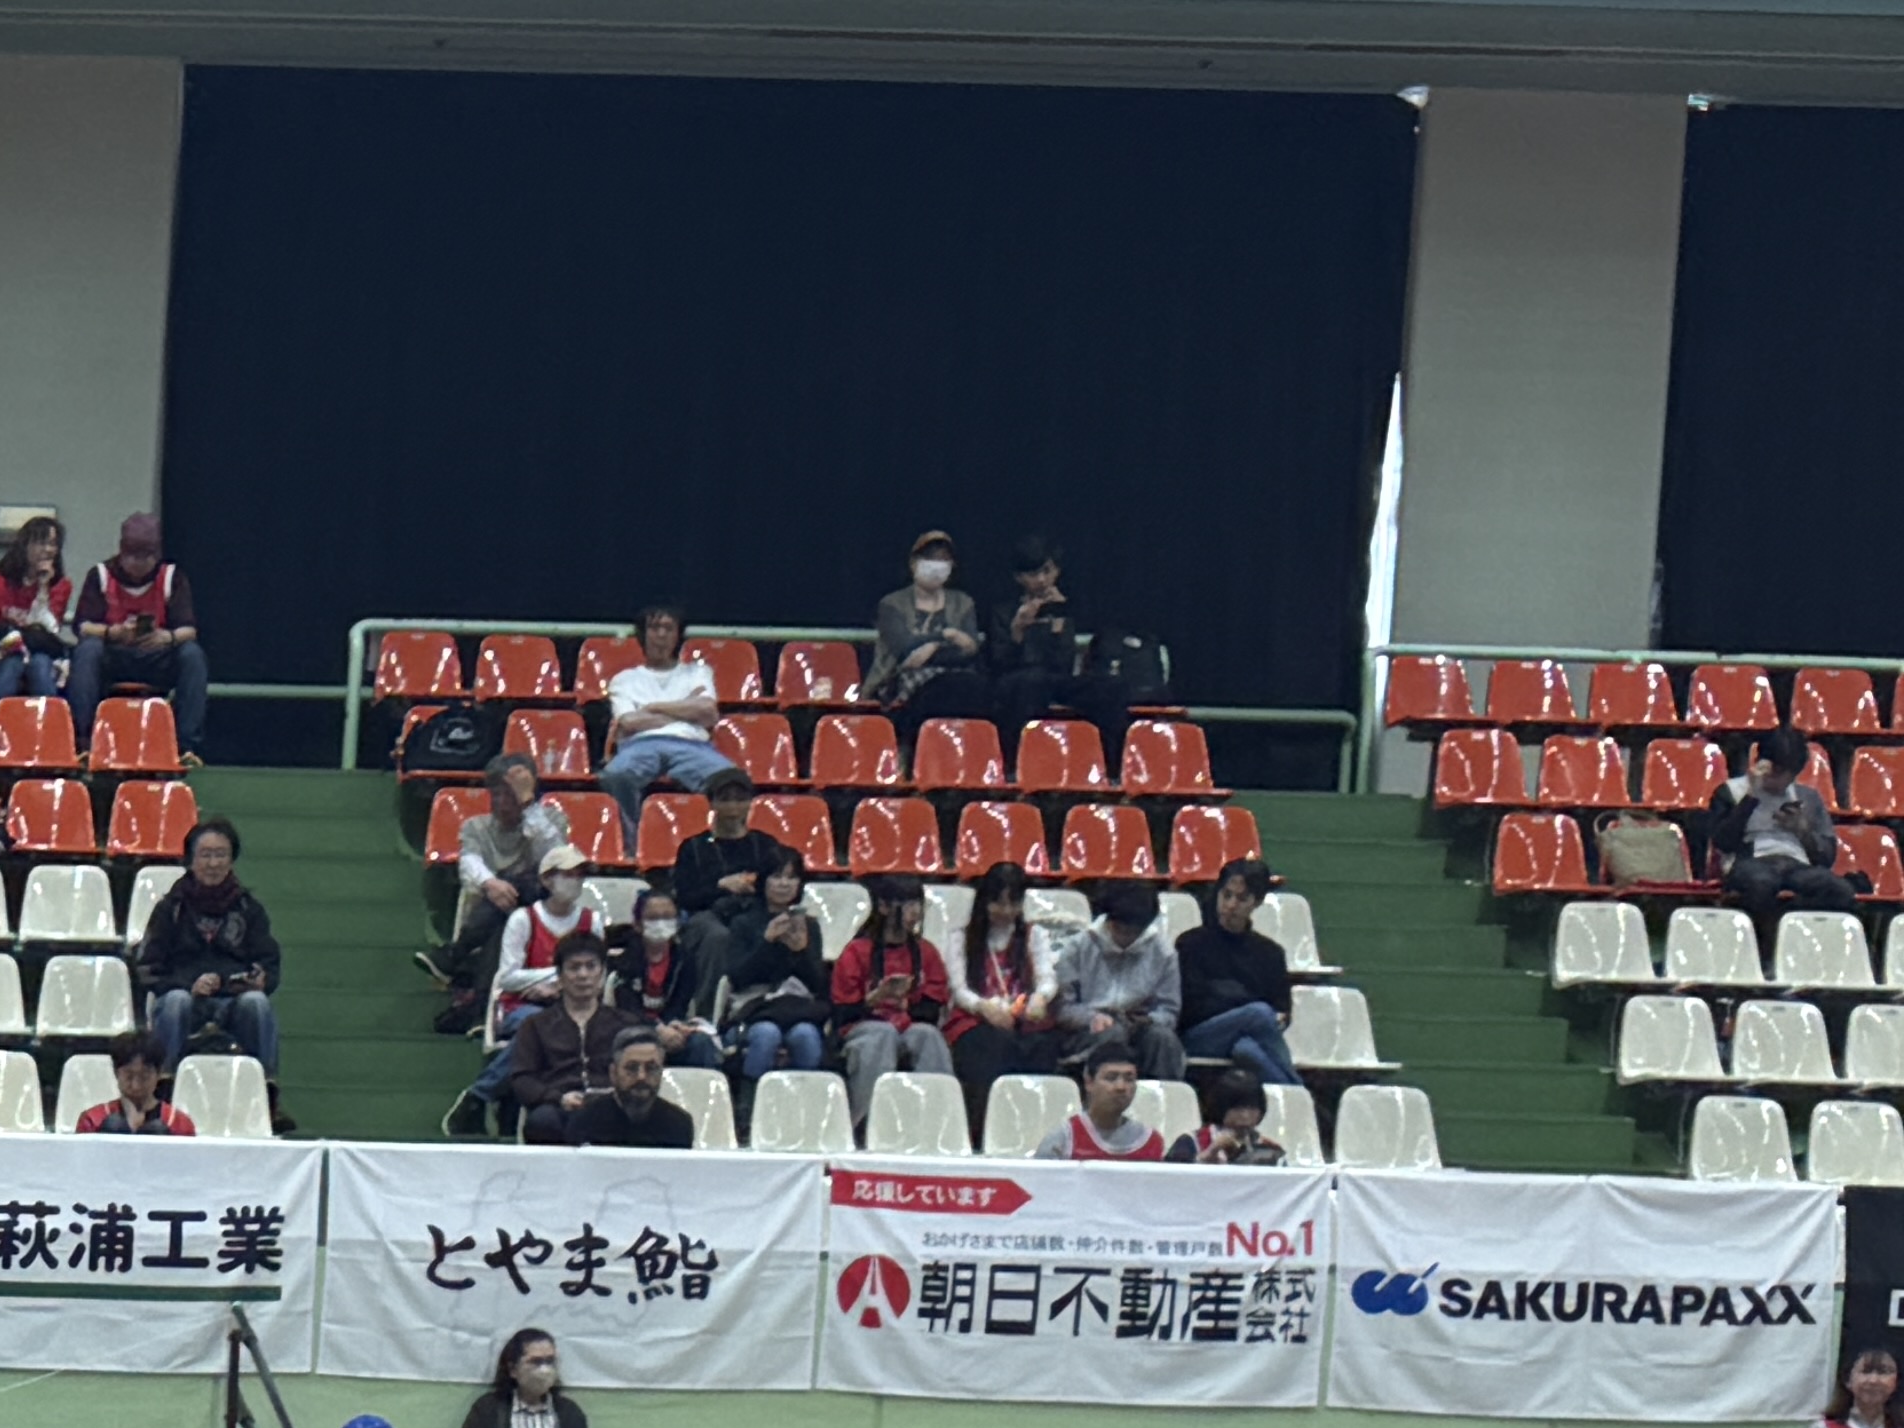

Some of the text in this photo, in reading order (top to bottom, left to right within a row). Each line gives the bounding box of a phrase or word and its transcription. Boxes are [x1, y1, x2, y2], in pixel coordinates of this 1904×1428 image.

[852, 1178, 998, 1208] 応援しています
[1226, 1219, 1315, 1258] No.1
[425, 1222, 719, 1305] とやま鮨
[917, 1260, 1246, 1343] 朝日不動産
[1438, 1279, 1817, 1327] SAKURAPAXX
